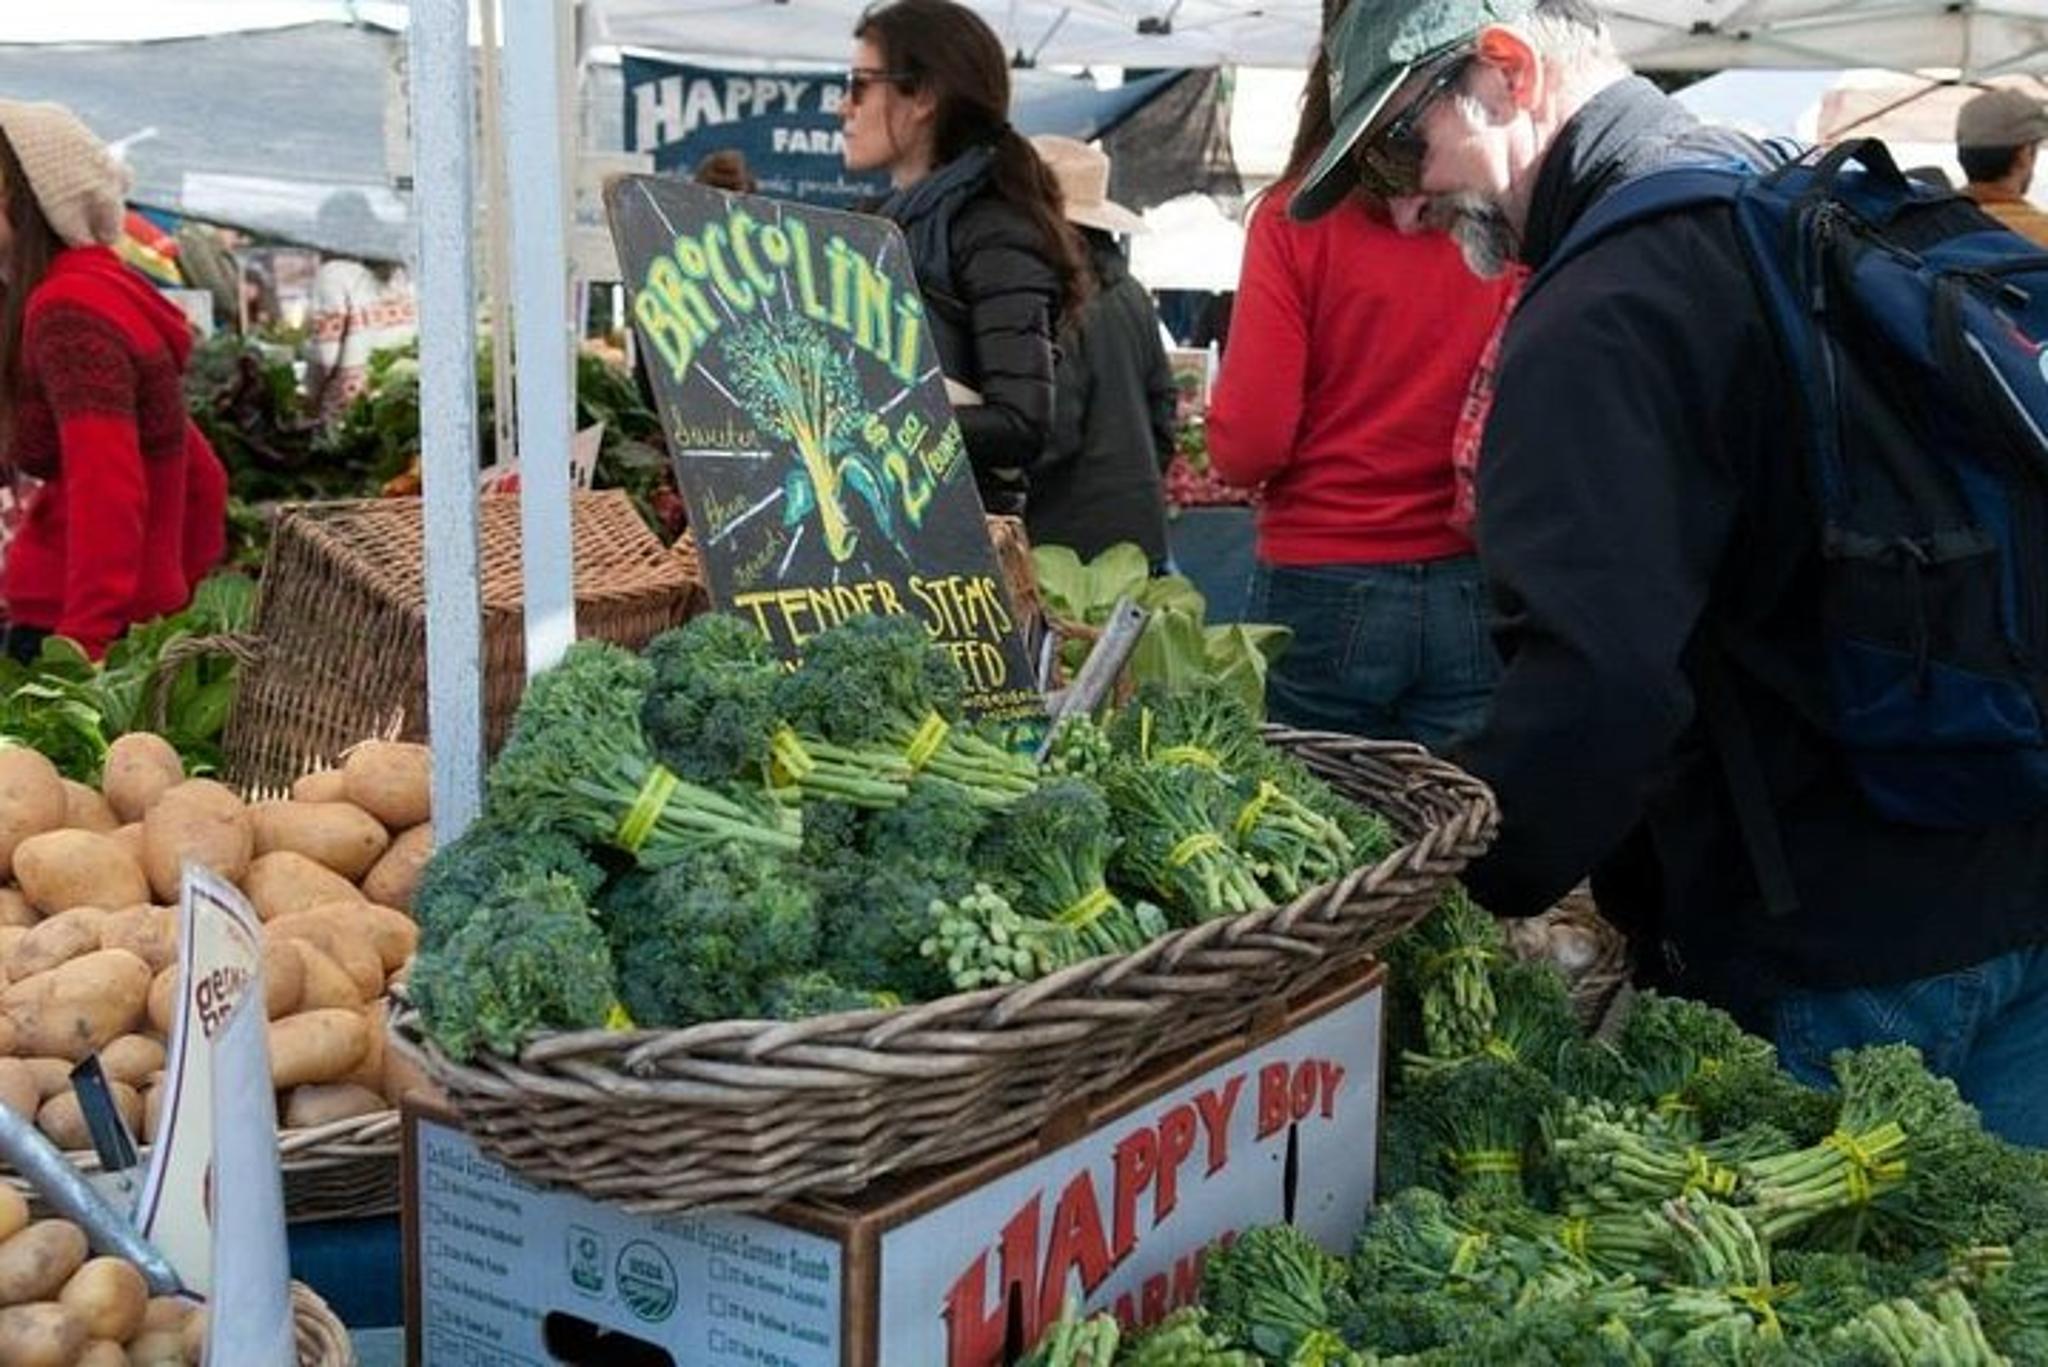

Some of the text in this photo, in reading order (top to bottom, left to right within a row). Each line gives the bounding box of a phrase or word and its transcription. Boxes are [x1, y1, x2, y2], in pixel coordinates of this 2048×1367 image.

[633, 75, 806, 152] HAPPY
[908, 575, 1013, 642] STEMS
[941, 1058, 1346, 1367] HAPPY BOY
